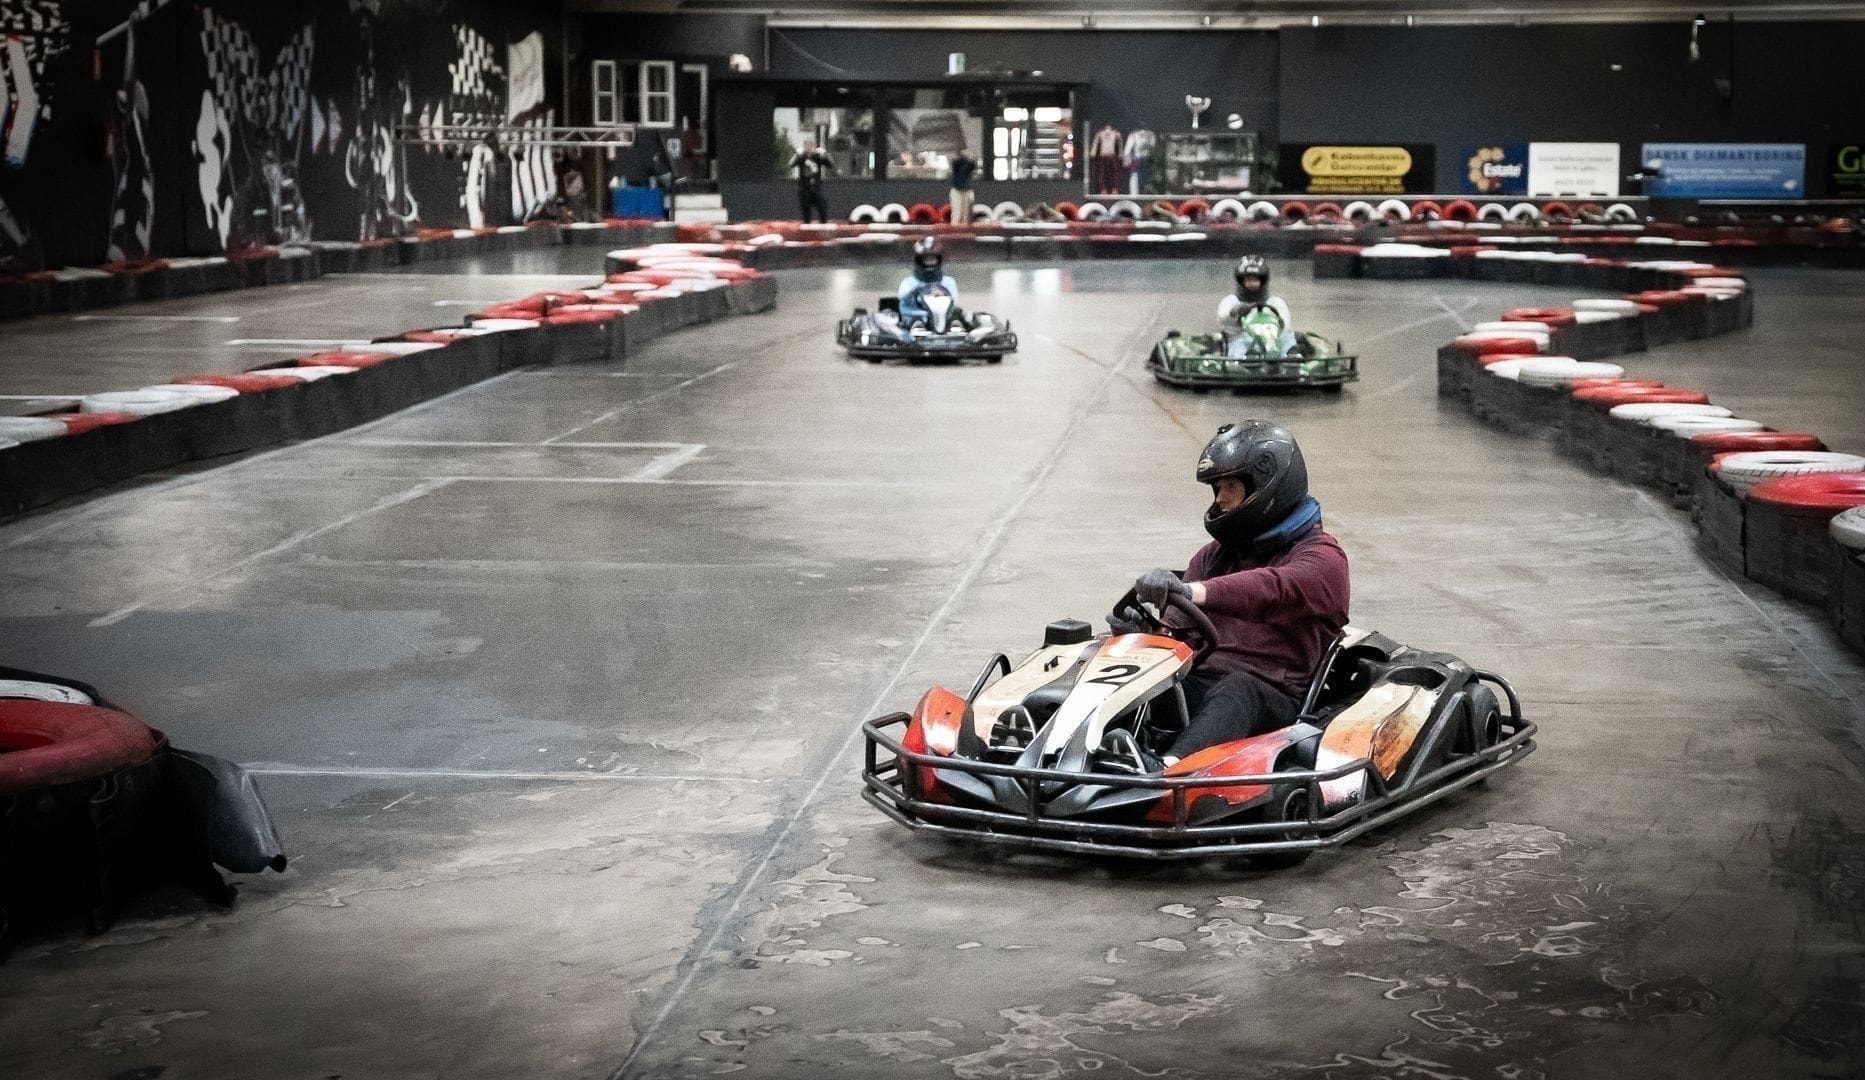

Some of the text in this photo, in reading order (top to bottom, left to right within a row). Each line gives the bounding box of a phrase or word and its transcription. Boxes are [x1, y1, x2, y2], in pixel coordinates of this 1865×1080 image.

[1646, 150, 1804, 160] DANSK DIAMANTBORING
[1086, 664, 1141, 686] 2
